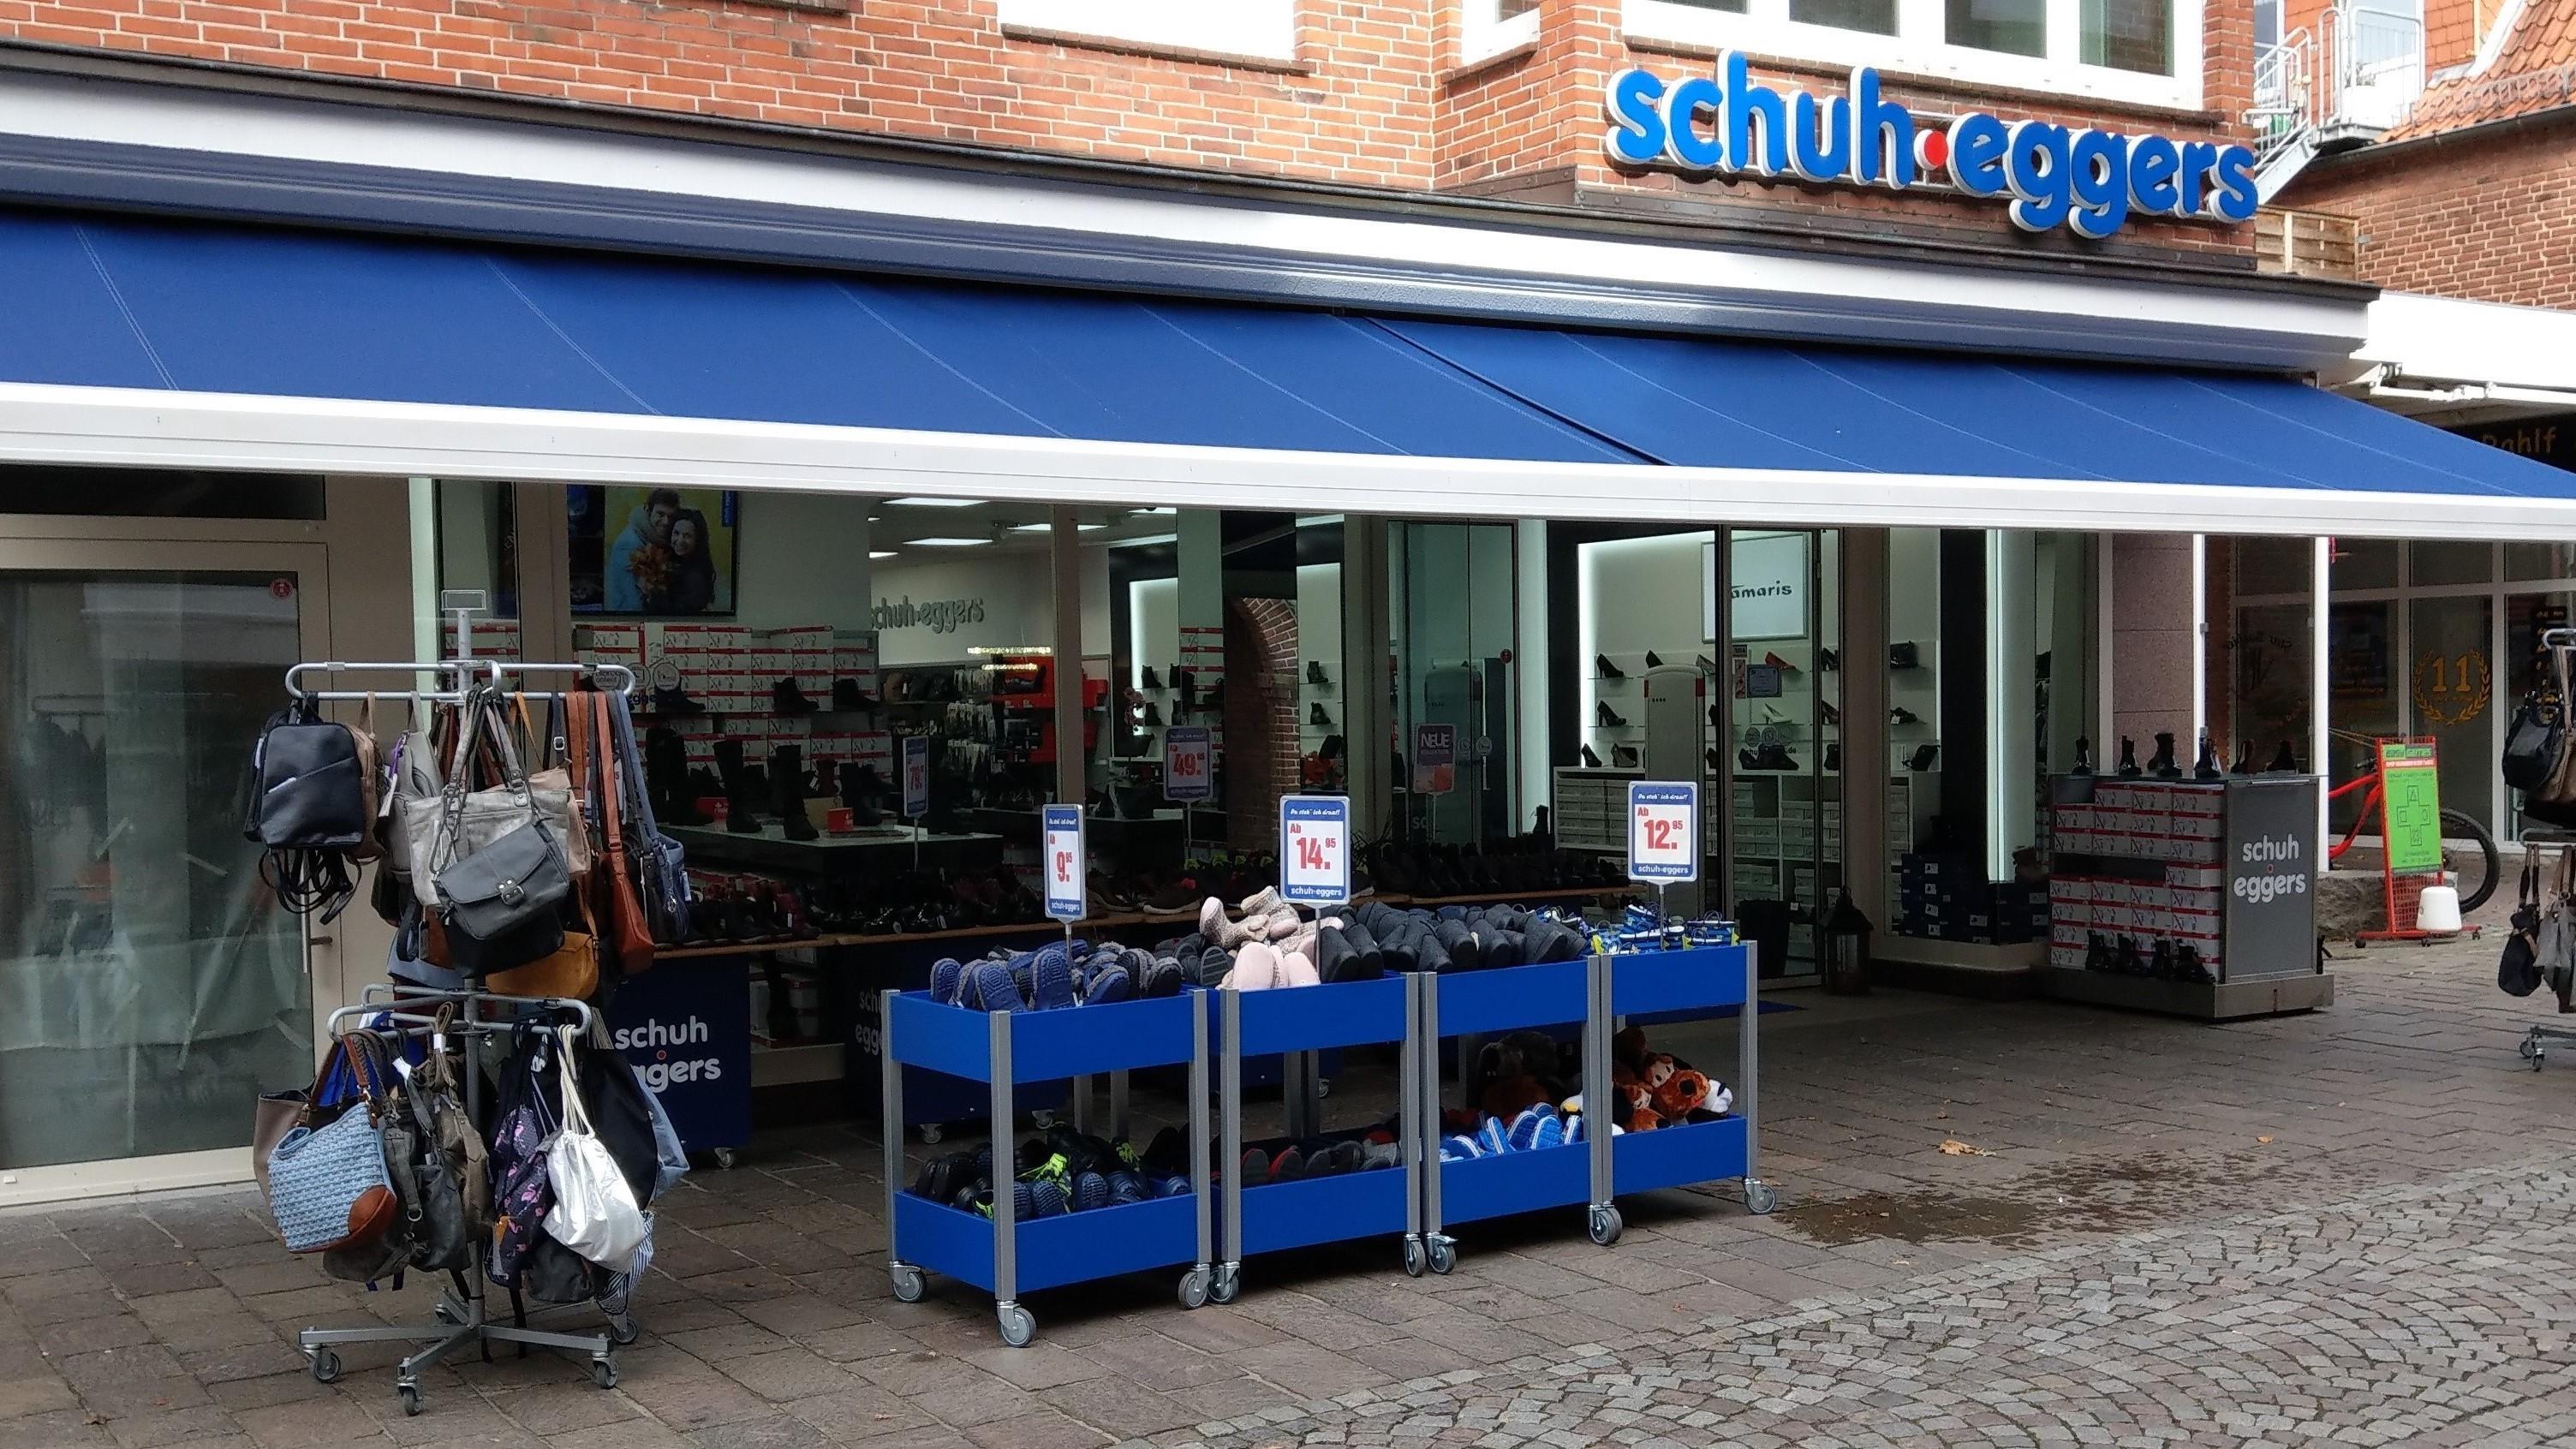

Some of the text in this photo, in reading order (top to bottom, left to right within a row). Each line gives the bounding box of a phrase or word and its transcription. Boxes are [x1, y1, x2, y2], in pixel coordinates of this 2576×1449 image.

[1421, 732, 1451, 748] NEUE
[1637, 807, 1649, 816] Ab
[1290, 823, 1302, 833] Ab
[2242, 833, 2299, 862] schuh
[2233, 873, 2306, 903] eggers
[859, 987, 881, 1014] sch
[615, 1015, 708, 1050] schuh
[856, 1023, 883, 1056] egg
[629, 1058, 722, 1094] gers
